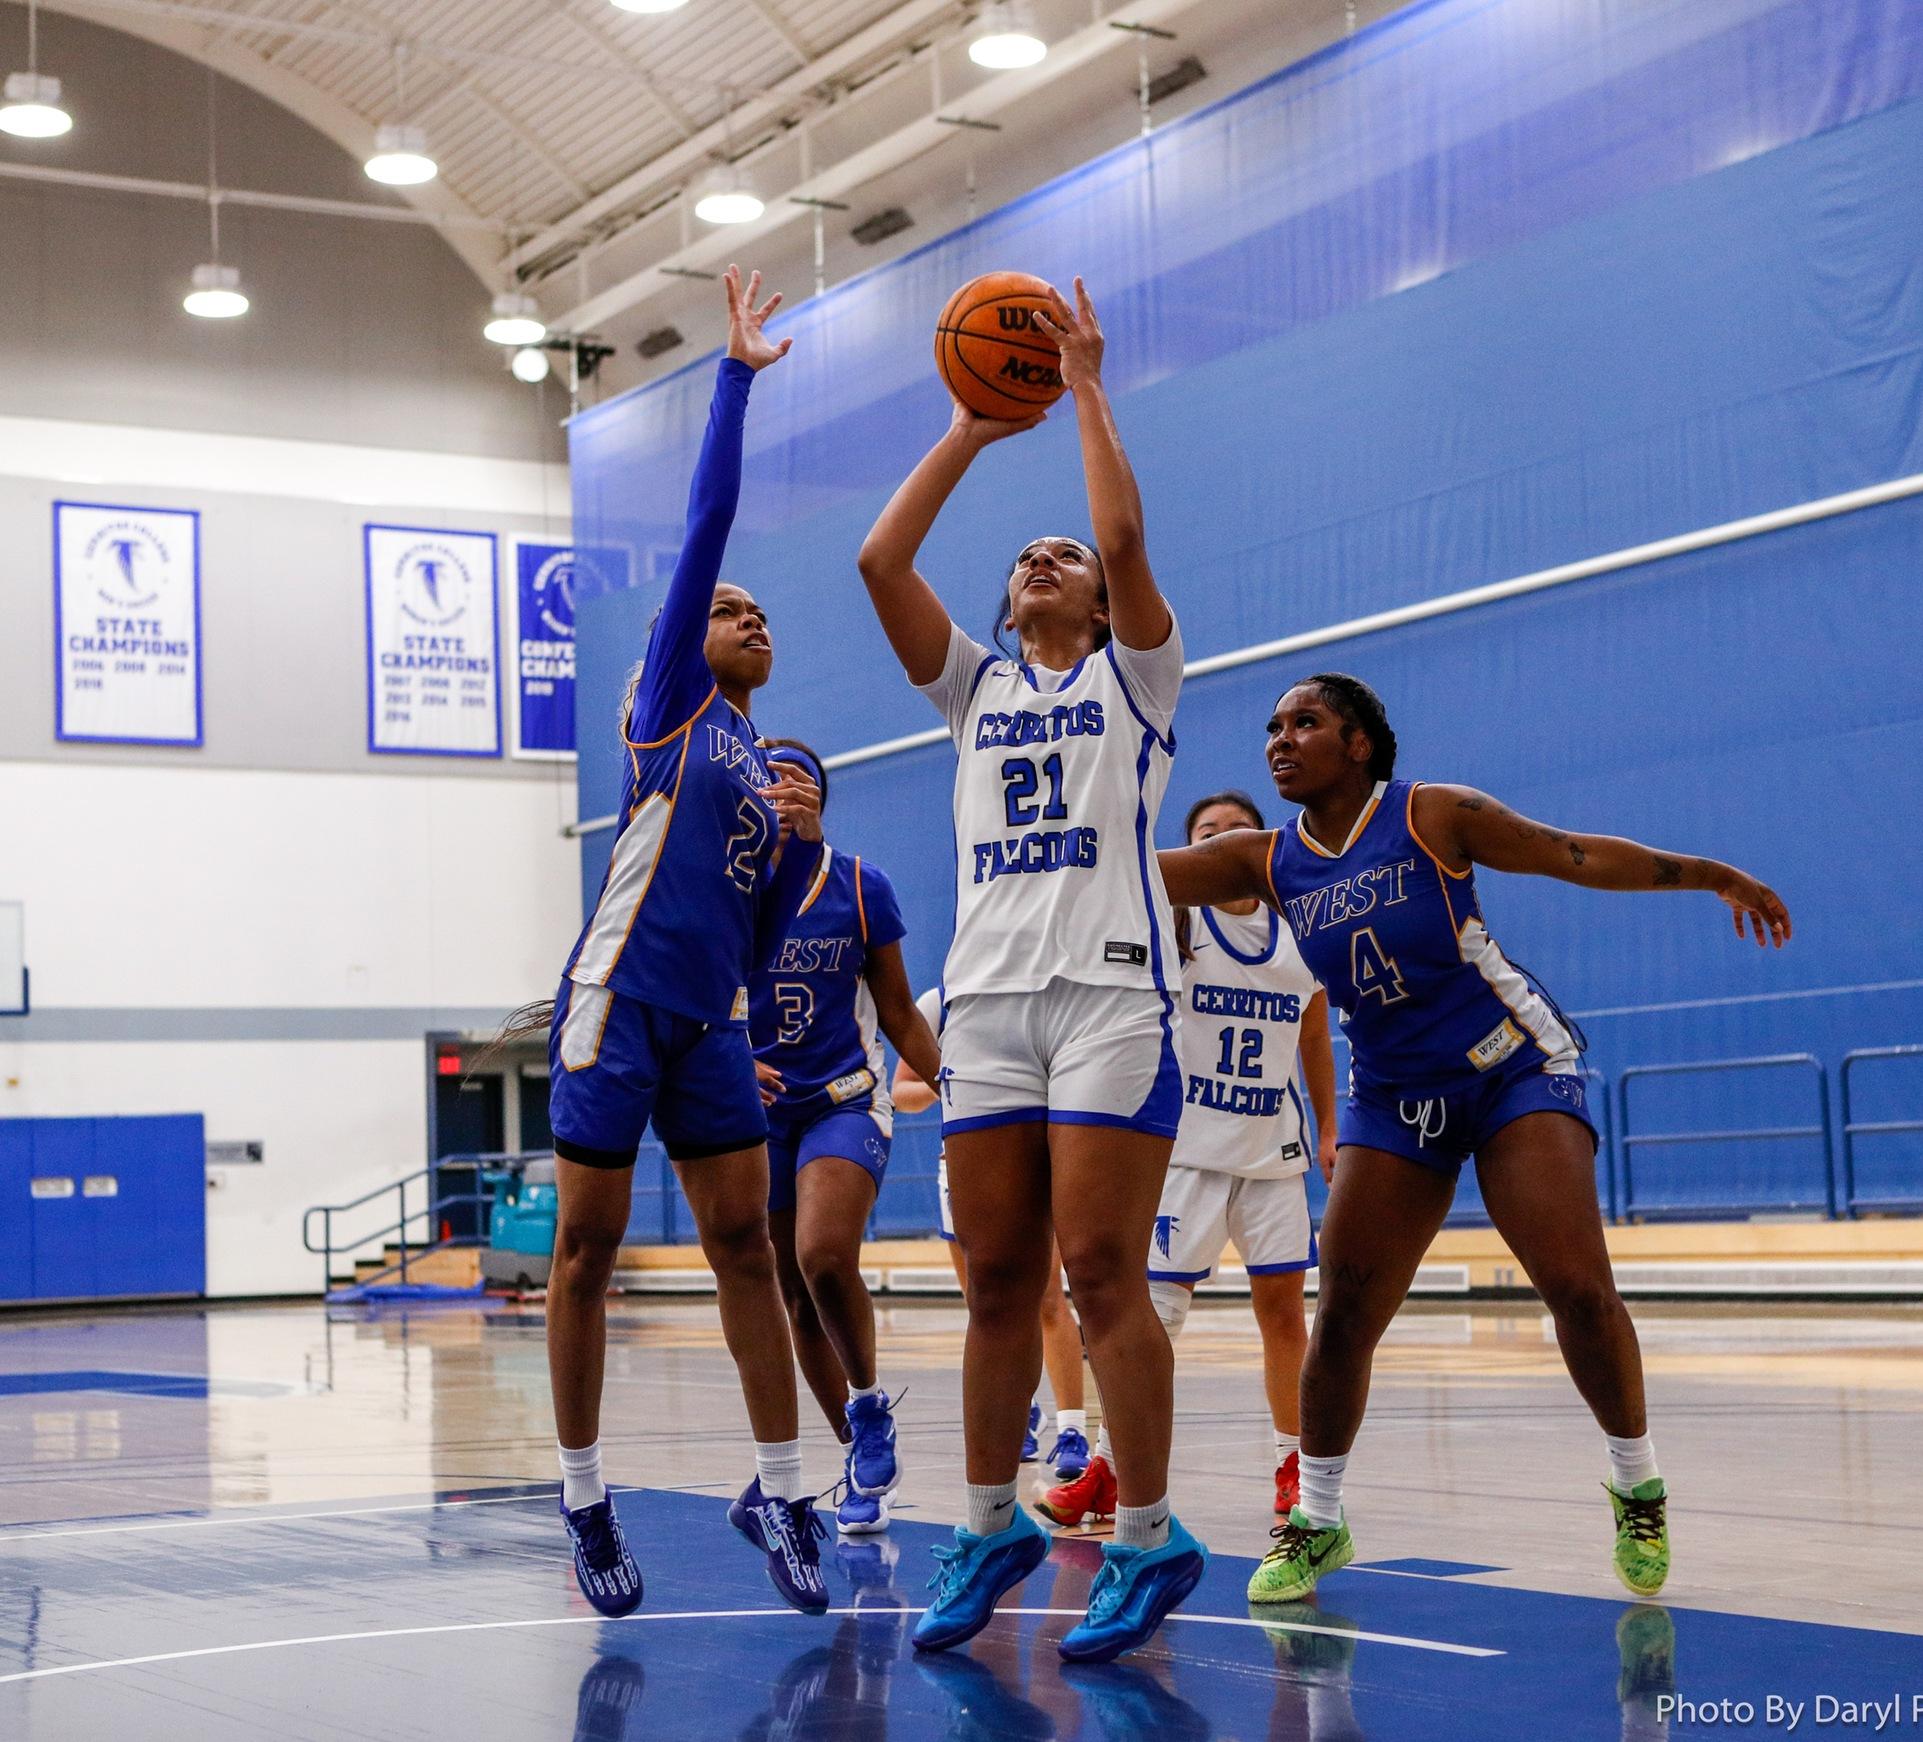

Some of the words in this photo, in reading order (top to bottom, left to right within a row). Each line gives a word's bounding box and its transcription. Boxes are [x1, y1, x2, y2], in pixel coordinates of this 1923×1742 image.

[69, 636, 188, 657] CHAMPIONS
[96, 617, 162, 636] STATE
[404, 636, 464, 653] STATE
[381, 653, 489, 674] CHAMPIONS
[975, 700, 1105, 751] CERRITOS
[707, 724, 776, 809] WES
[1001, 752, 1068, 827] 21
[724, 796, 768, 895] 2
[974, 827, 1098, 884] FALCONS
[1285, 858, 1415, 941] WEST
[768, 937, 852, 973] EST
[1351, 926, 1411, 1005] 4
[775, 982, 815, 1044] 3
[1192, 984, 1300, 1023] CERRITOS
[1216, 1026, 1264, 1078] 12
[1478, 1029, 1504, 1056] WEST
